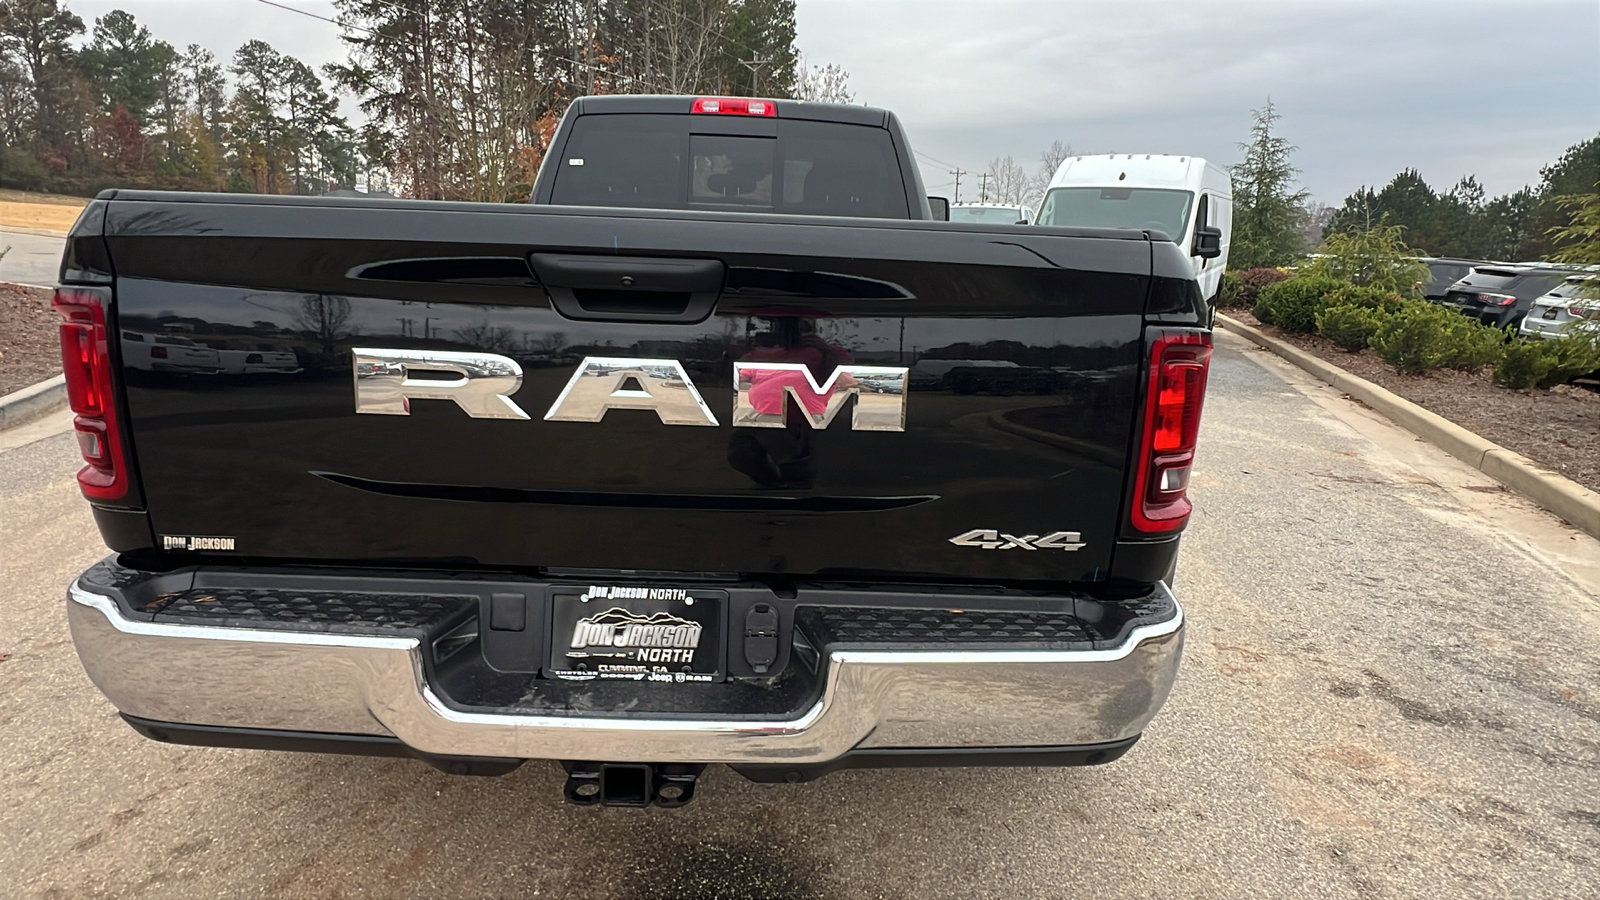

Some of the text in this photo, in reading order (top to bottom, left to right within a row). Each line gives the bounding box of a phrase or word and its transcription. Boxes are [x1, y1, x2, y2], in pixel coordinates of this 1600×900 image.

[352, 347, 909, 432] RAM
[164, 536, 235, 550] DON JACKSON
[589, 586, 686, 600] DON JACKSON NORTH
[571, 622, 702, 648] DON JACKSON
[637, 649, 694, 662] NORTH
[648, 672, 673, 682] Jeep
